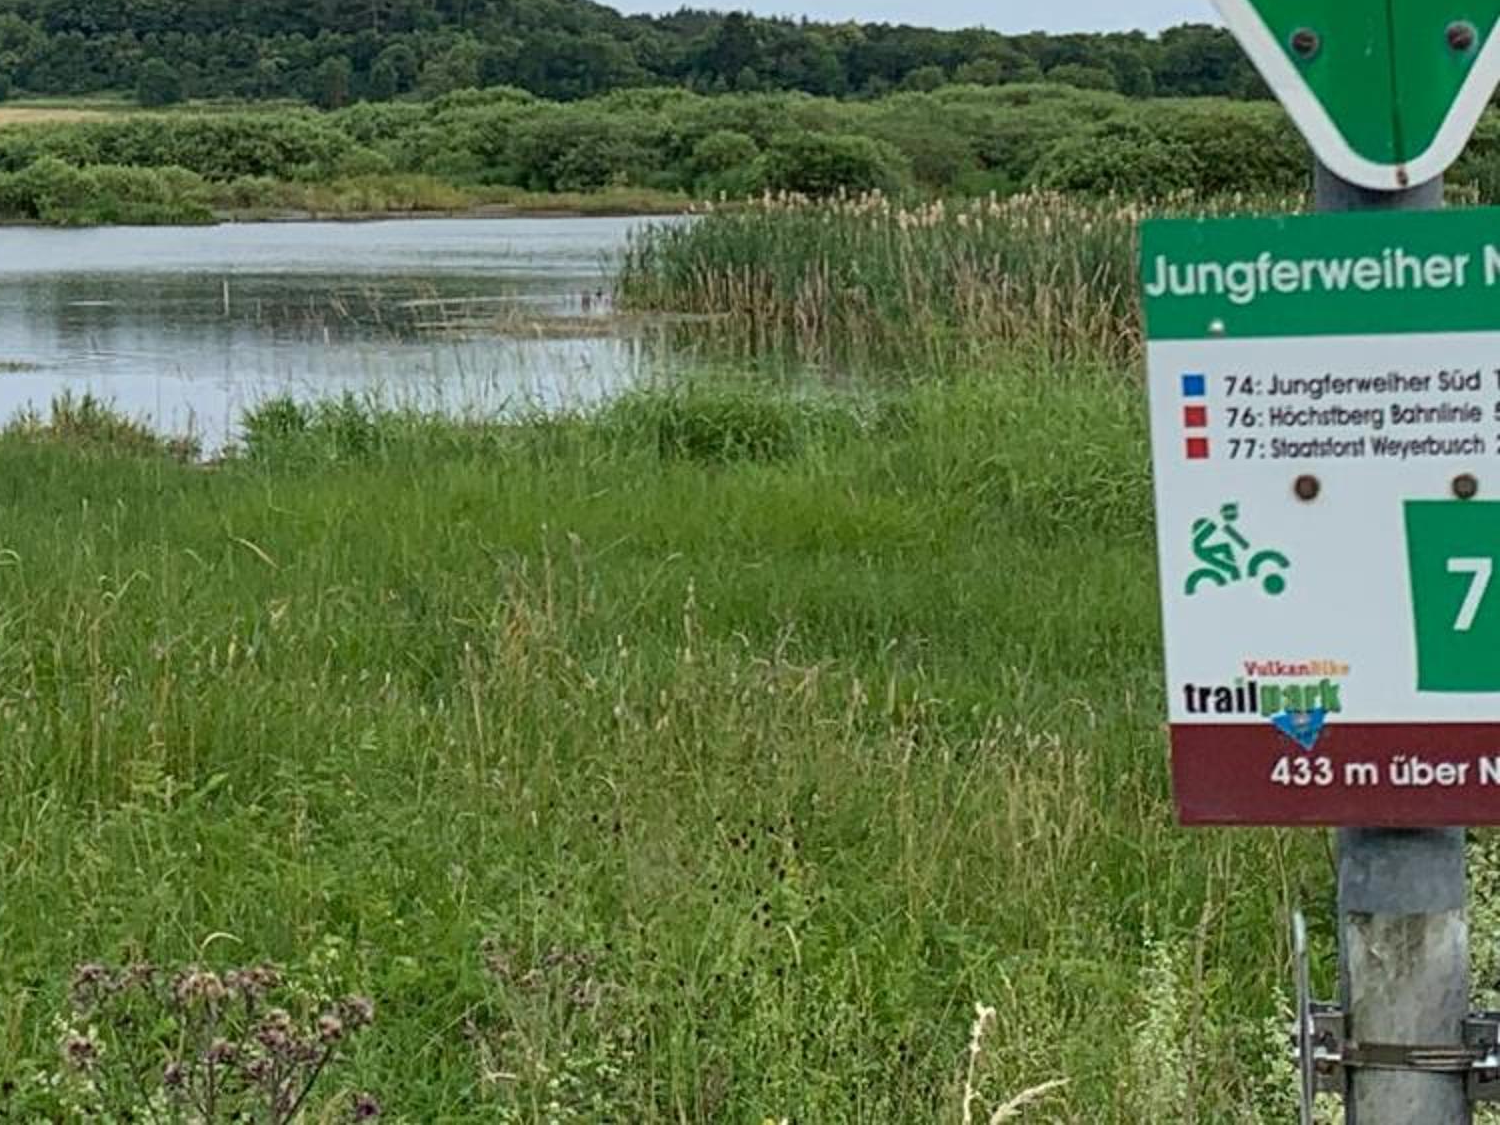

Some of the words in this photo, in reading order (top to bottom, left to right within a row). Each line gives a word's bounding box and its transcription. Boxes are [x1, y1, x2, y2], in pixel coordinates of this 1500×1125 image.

[1146, 248, 1469, 304] Jungferweiher
[1224, 375, 1261, 396] 74:
[1267, 372, 1430, 400] Jungferweiher
[1439, 370, 1481, 391] Süd
[1226, 407, 1264, 428] 76:
[1269, 404, 1384, 430] Höchstberg
[1391, 402, 1482, 425] Bahnlinie
[1228, 438, 1266, 460] 77:
[1270, 436, 1364, 459] Staatsforst
[1371, 434, 1484, 461] Weyerbusch
[1447, 557, 1492, 631] 7
[1270, 757, 1333, 785] 433
[1345, 761, 1377, 785] m
[1390, 755, 1469, 786] über
